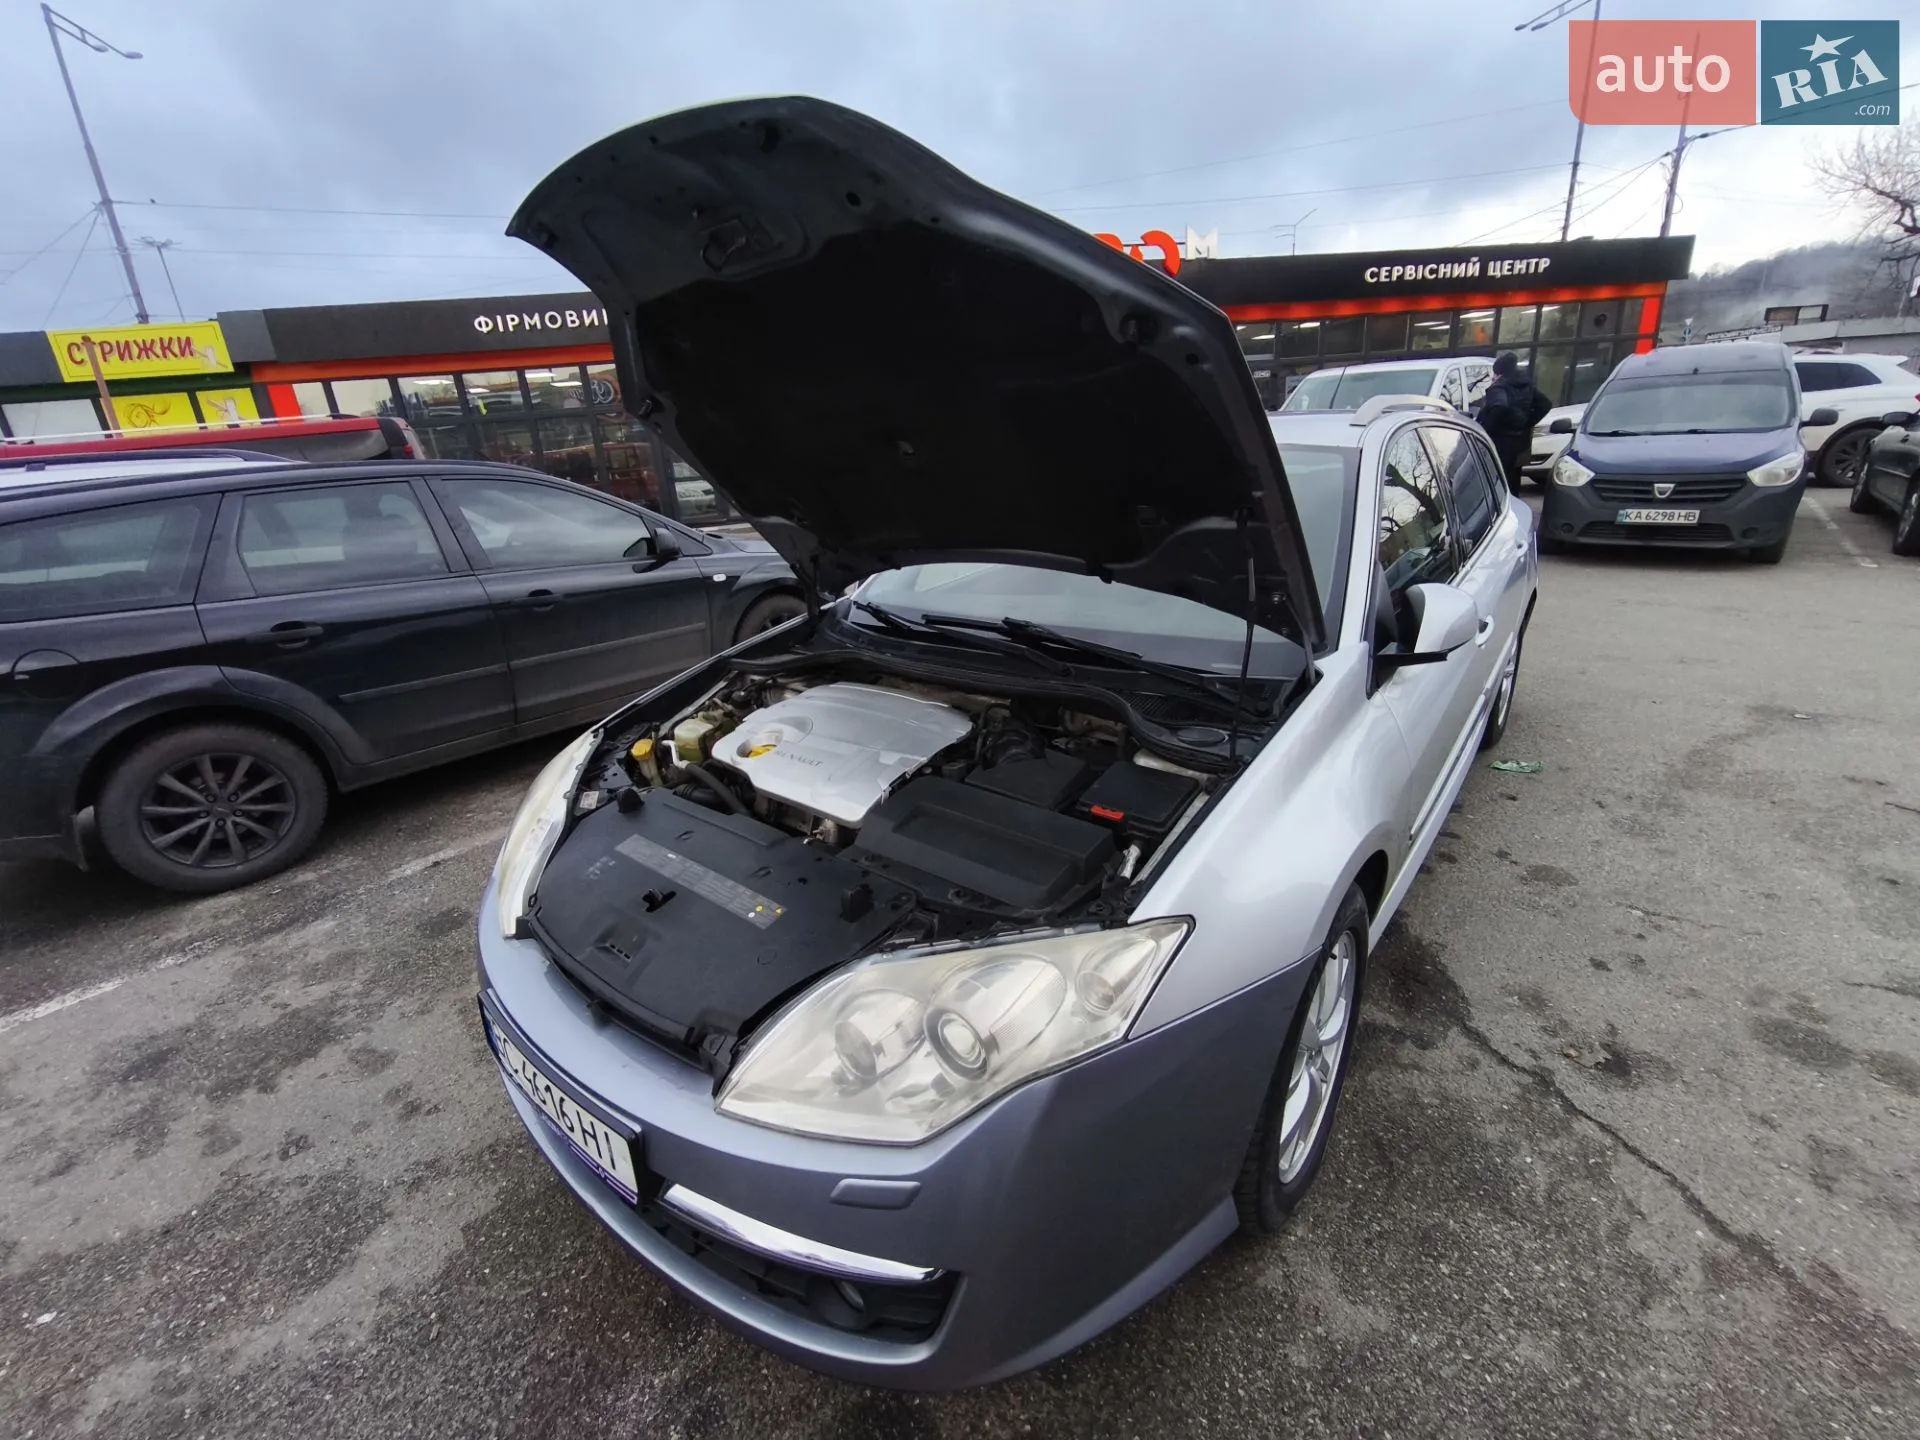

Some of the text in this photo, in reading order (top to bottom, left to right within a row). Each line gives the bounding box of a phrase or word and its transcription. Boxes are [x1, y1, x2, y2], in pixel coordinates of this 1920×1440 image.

[1364, 256, 1551, 283] СЕРВІСНИЙ ЦЕНТР
[1624, 511, 1642, 521] KA
[1645, 511, 1676, 521] 6298
[575, 1108, 617, 1171] HI
